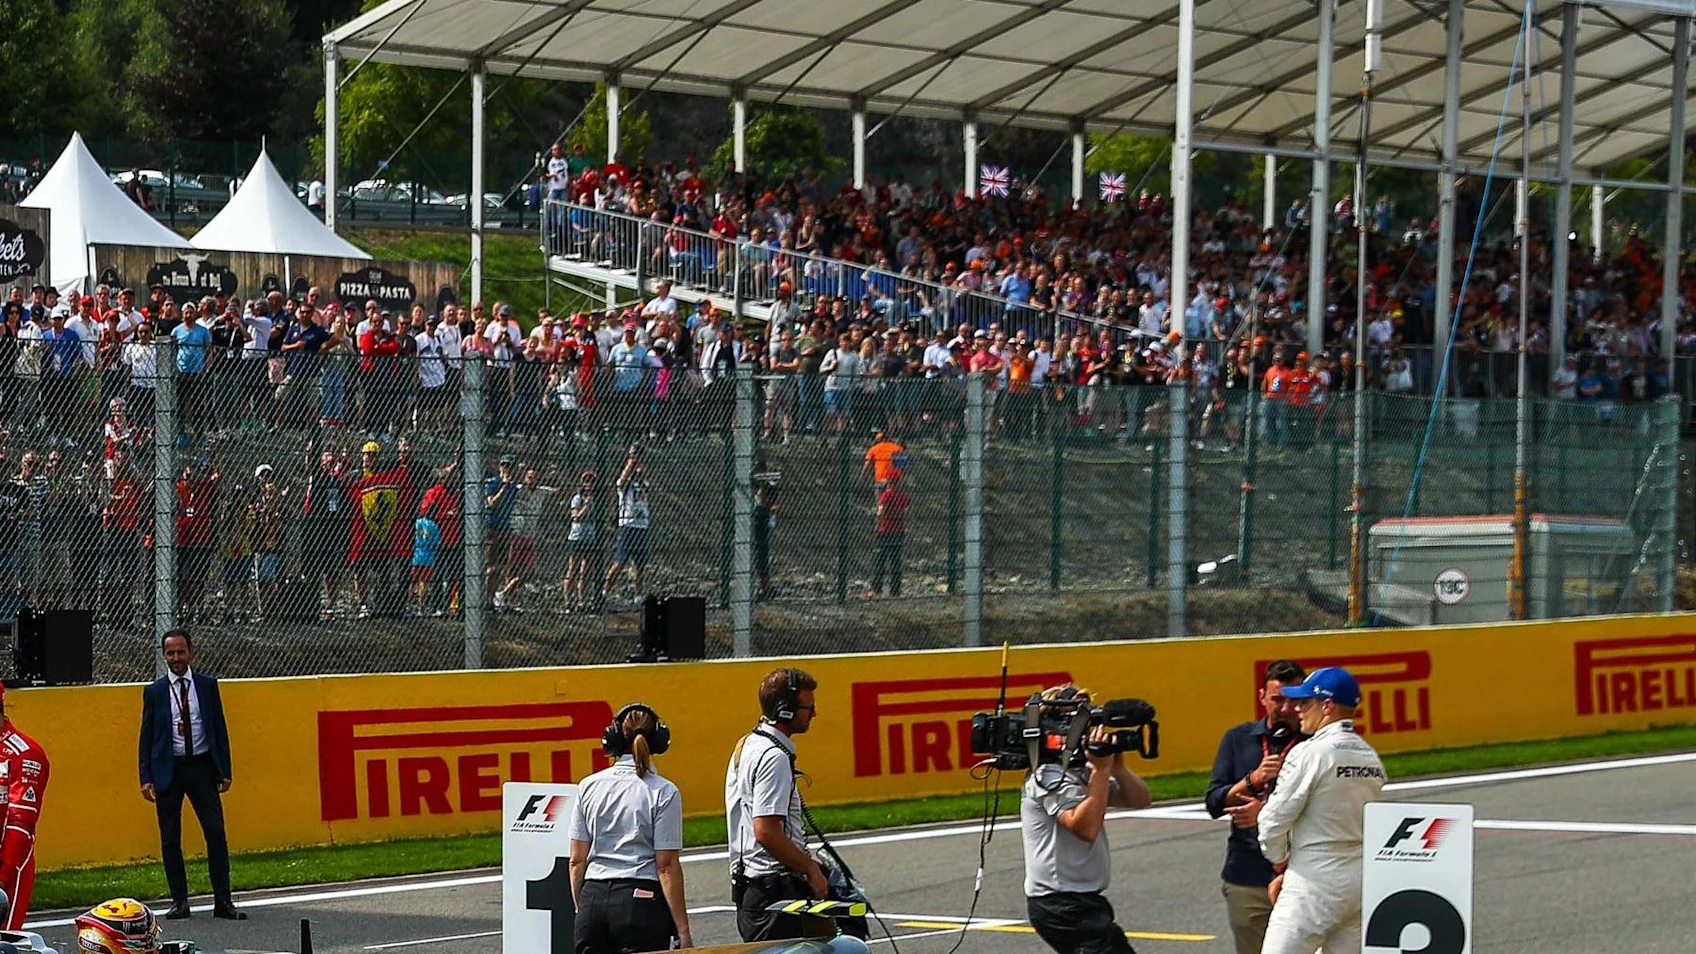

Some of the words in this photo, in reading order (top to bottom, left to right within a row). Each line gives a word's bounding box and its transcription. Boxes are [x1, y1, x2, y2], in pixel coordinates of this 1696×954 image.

[340, 283, 371, 297] PIZZA
[380, 286, 412, 300] PASTA
[517, 795, 571, 821] F1
[1384, 818, 1460, 850] F1
